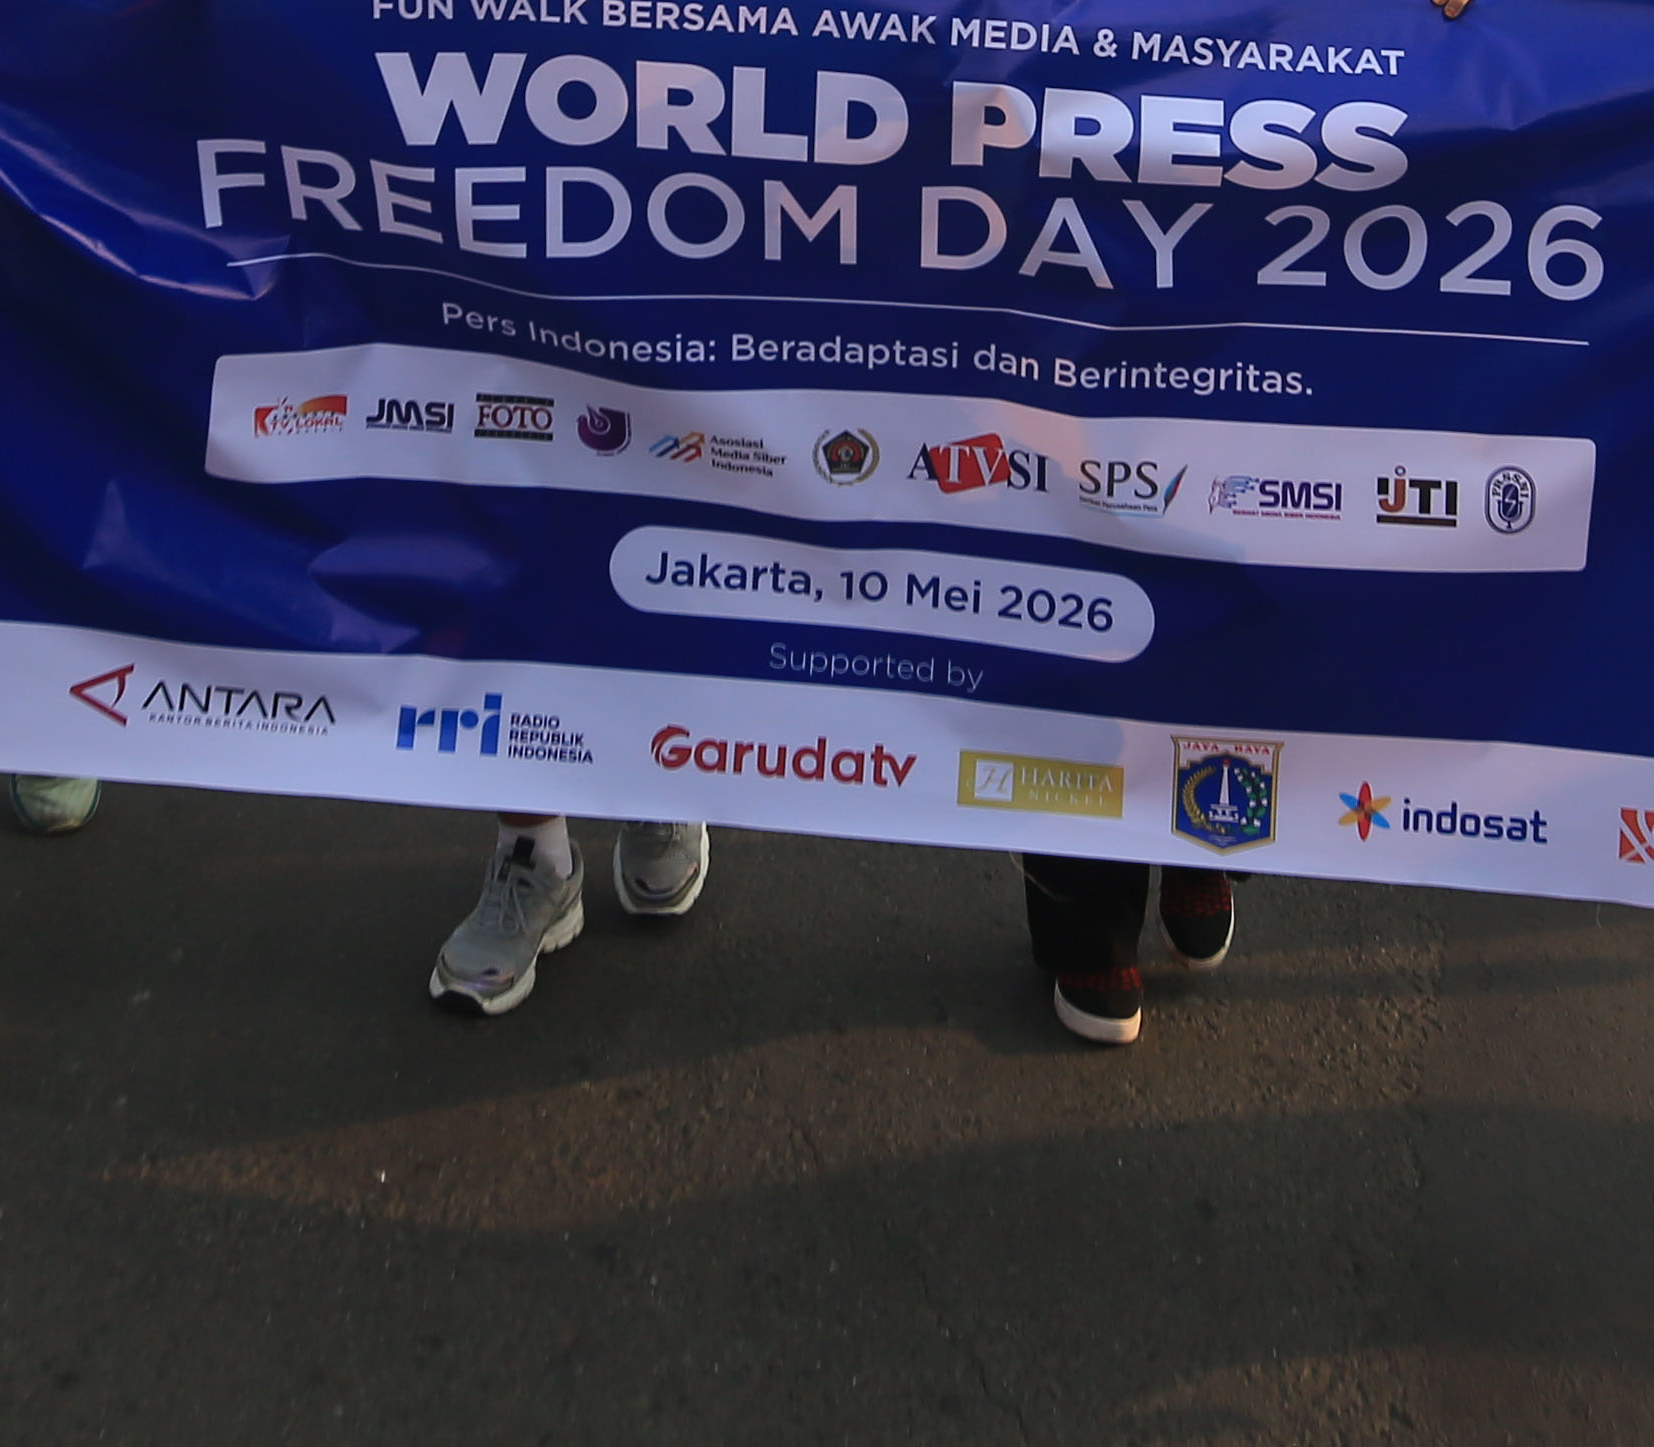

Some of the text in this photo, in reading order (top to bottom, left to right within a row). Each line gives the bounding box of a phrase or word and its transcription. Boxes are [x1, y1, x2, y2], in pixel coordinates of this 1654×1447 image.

[602, 0, 799, 37] BERSAMA
[812, 9, 937, 45] AWAK
[950, 17, 1080, 56] MEDIA
[1093, 27, 1119, 59] &
[1131, 30, 1406, 77] MASYARAKAT
[374, 52, 1409, 192] WORLD PRESS
[196, 138, 1606, 302] FREEDOM DAY 2026
[441, 302, 1314, 398] Pers Indonesia: Beradaptasi dan Berintegritas.
[366, 398, 454, 428] JMSI
[477, 402, 553, 432] FOTO
[710, 434, 764, 450] Asosiasi
[711, 446, 786, 464] Media Siber
[712, 458, 773, 477] Indonesia
[907, 442, 1050, 493] ATVSI
[1078, 460, 1159, 499] SPS
[1258, 479, 1342, 512] SMSI
[645, 552, 1114, 634] Jakarta, 10 Mei 2026
[769, 641, 985, 692] Supported by
[141, 679, 337, 725] ANTARA
[509, 712, 561, 731] RADIO
[149, 711, 329, 737] KANTOR BERITA INDONESIA
[395, 692, 503, 758] rri
[508, 728, 585, 748] REPUBLIK
[507, 744, 595, 765] INDONESIA
[651, 723, 918, 788] Garudatv
[1021, 765, 1115, 794] HARITA
[1401, 797, 1550, 845] indosat
